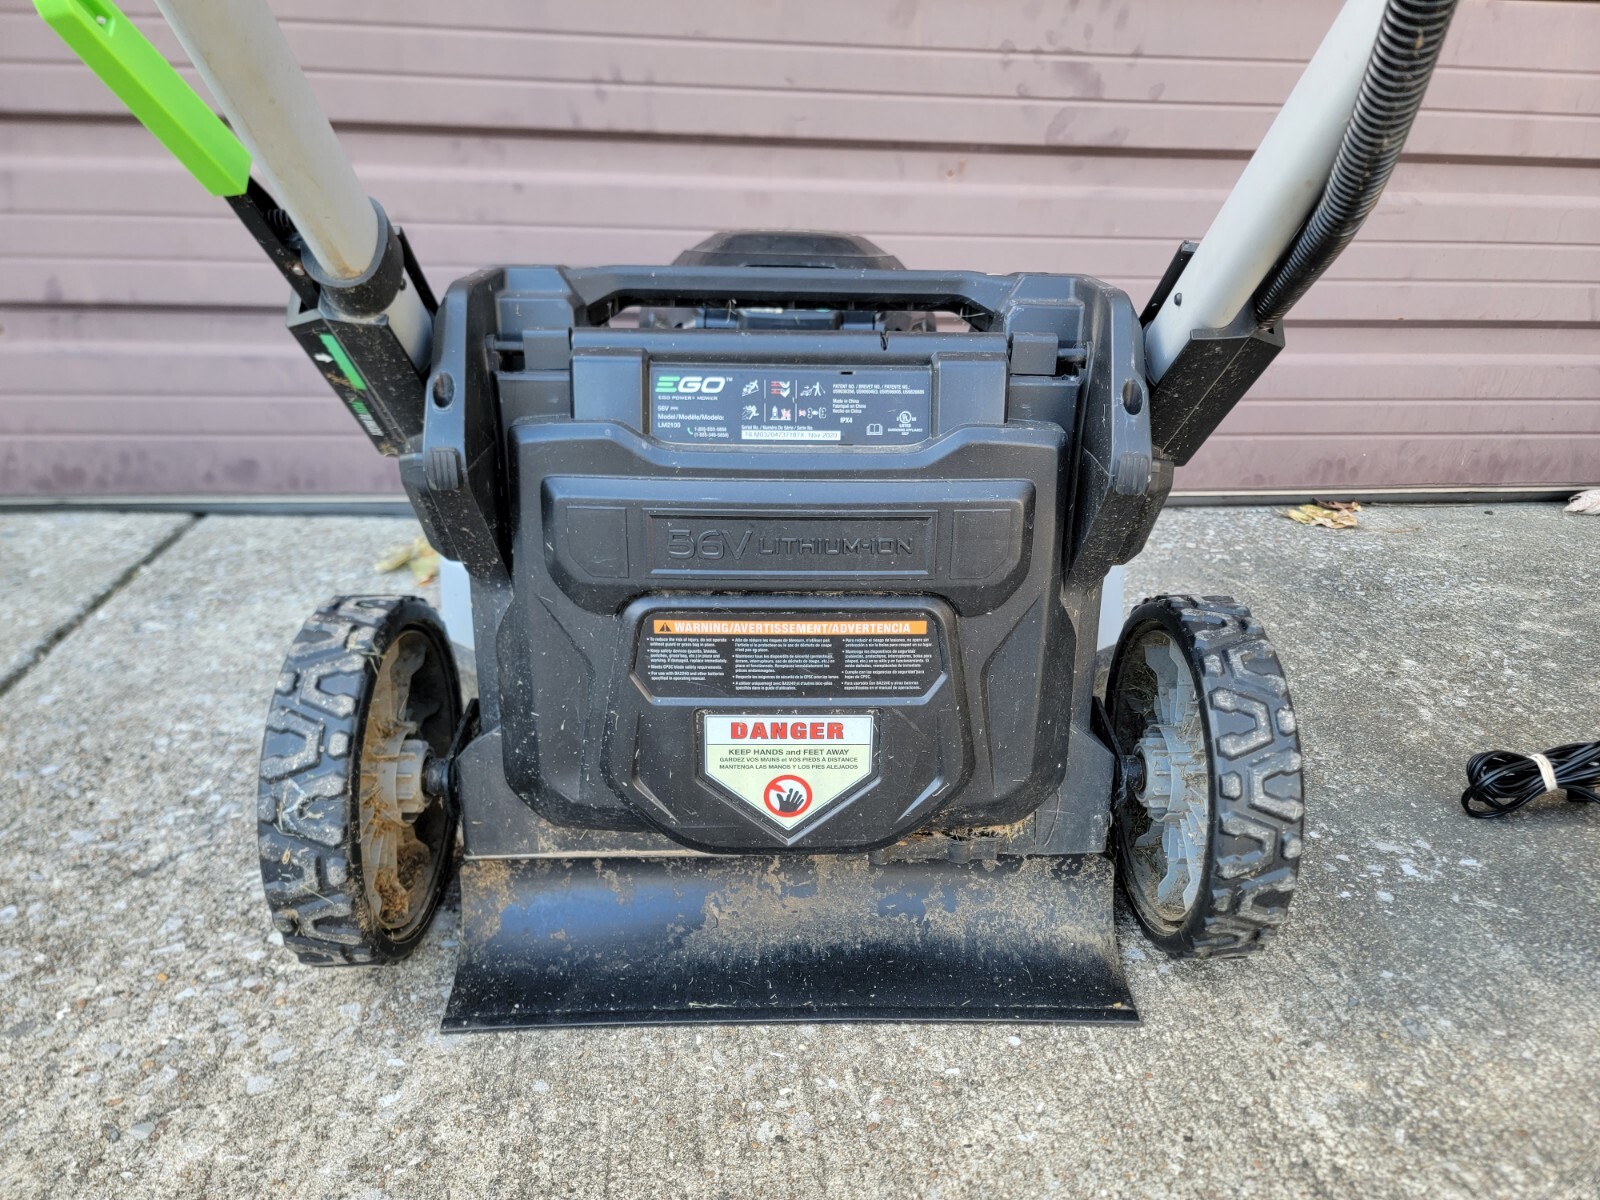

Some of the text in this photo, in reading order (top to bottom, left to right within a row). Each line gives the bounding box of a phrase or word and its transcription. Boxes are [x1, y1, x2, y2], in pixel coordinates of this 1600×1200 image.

[655, 376, 726, 393] EGO
[668, 529, 913, 560] 56V LITHIUM-ION
[674, 622, 911, 634] WARNING/AVERTISSEMENT/ADVERTENCIA
[730, 722, 844, 740] DANGER
